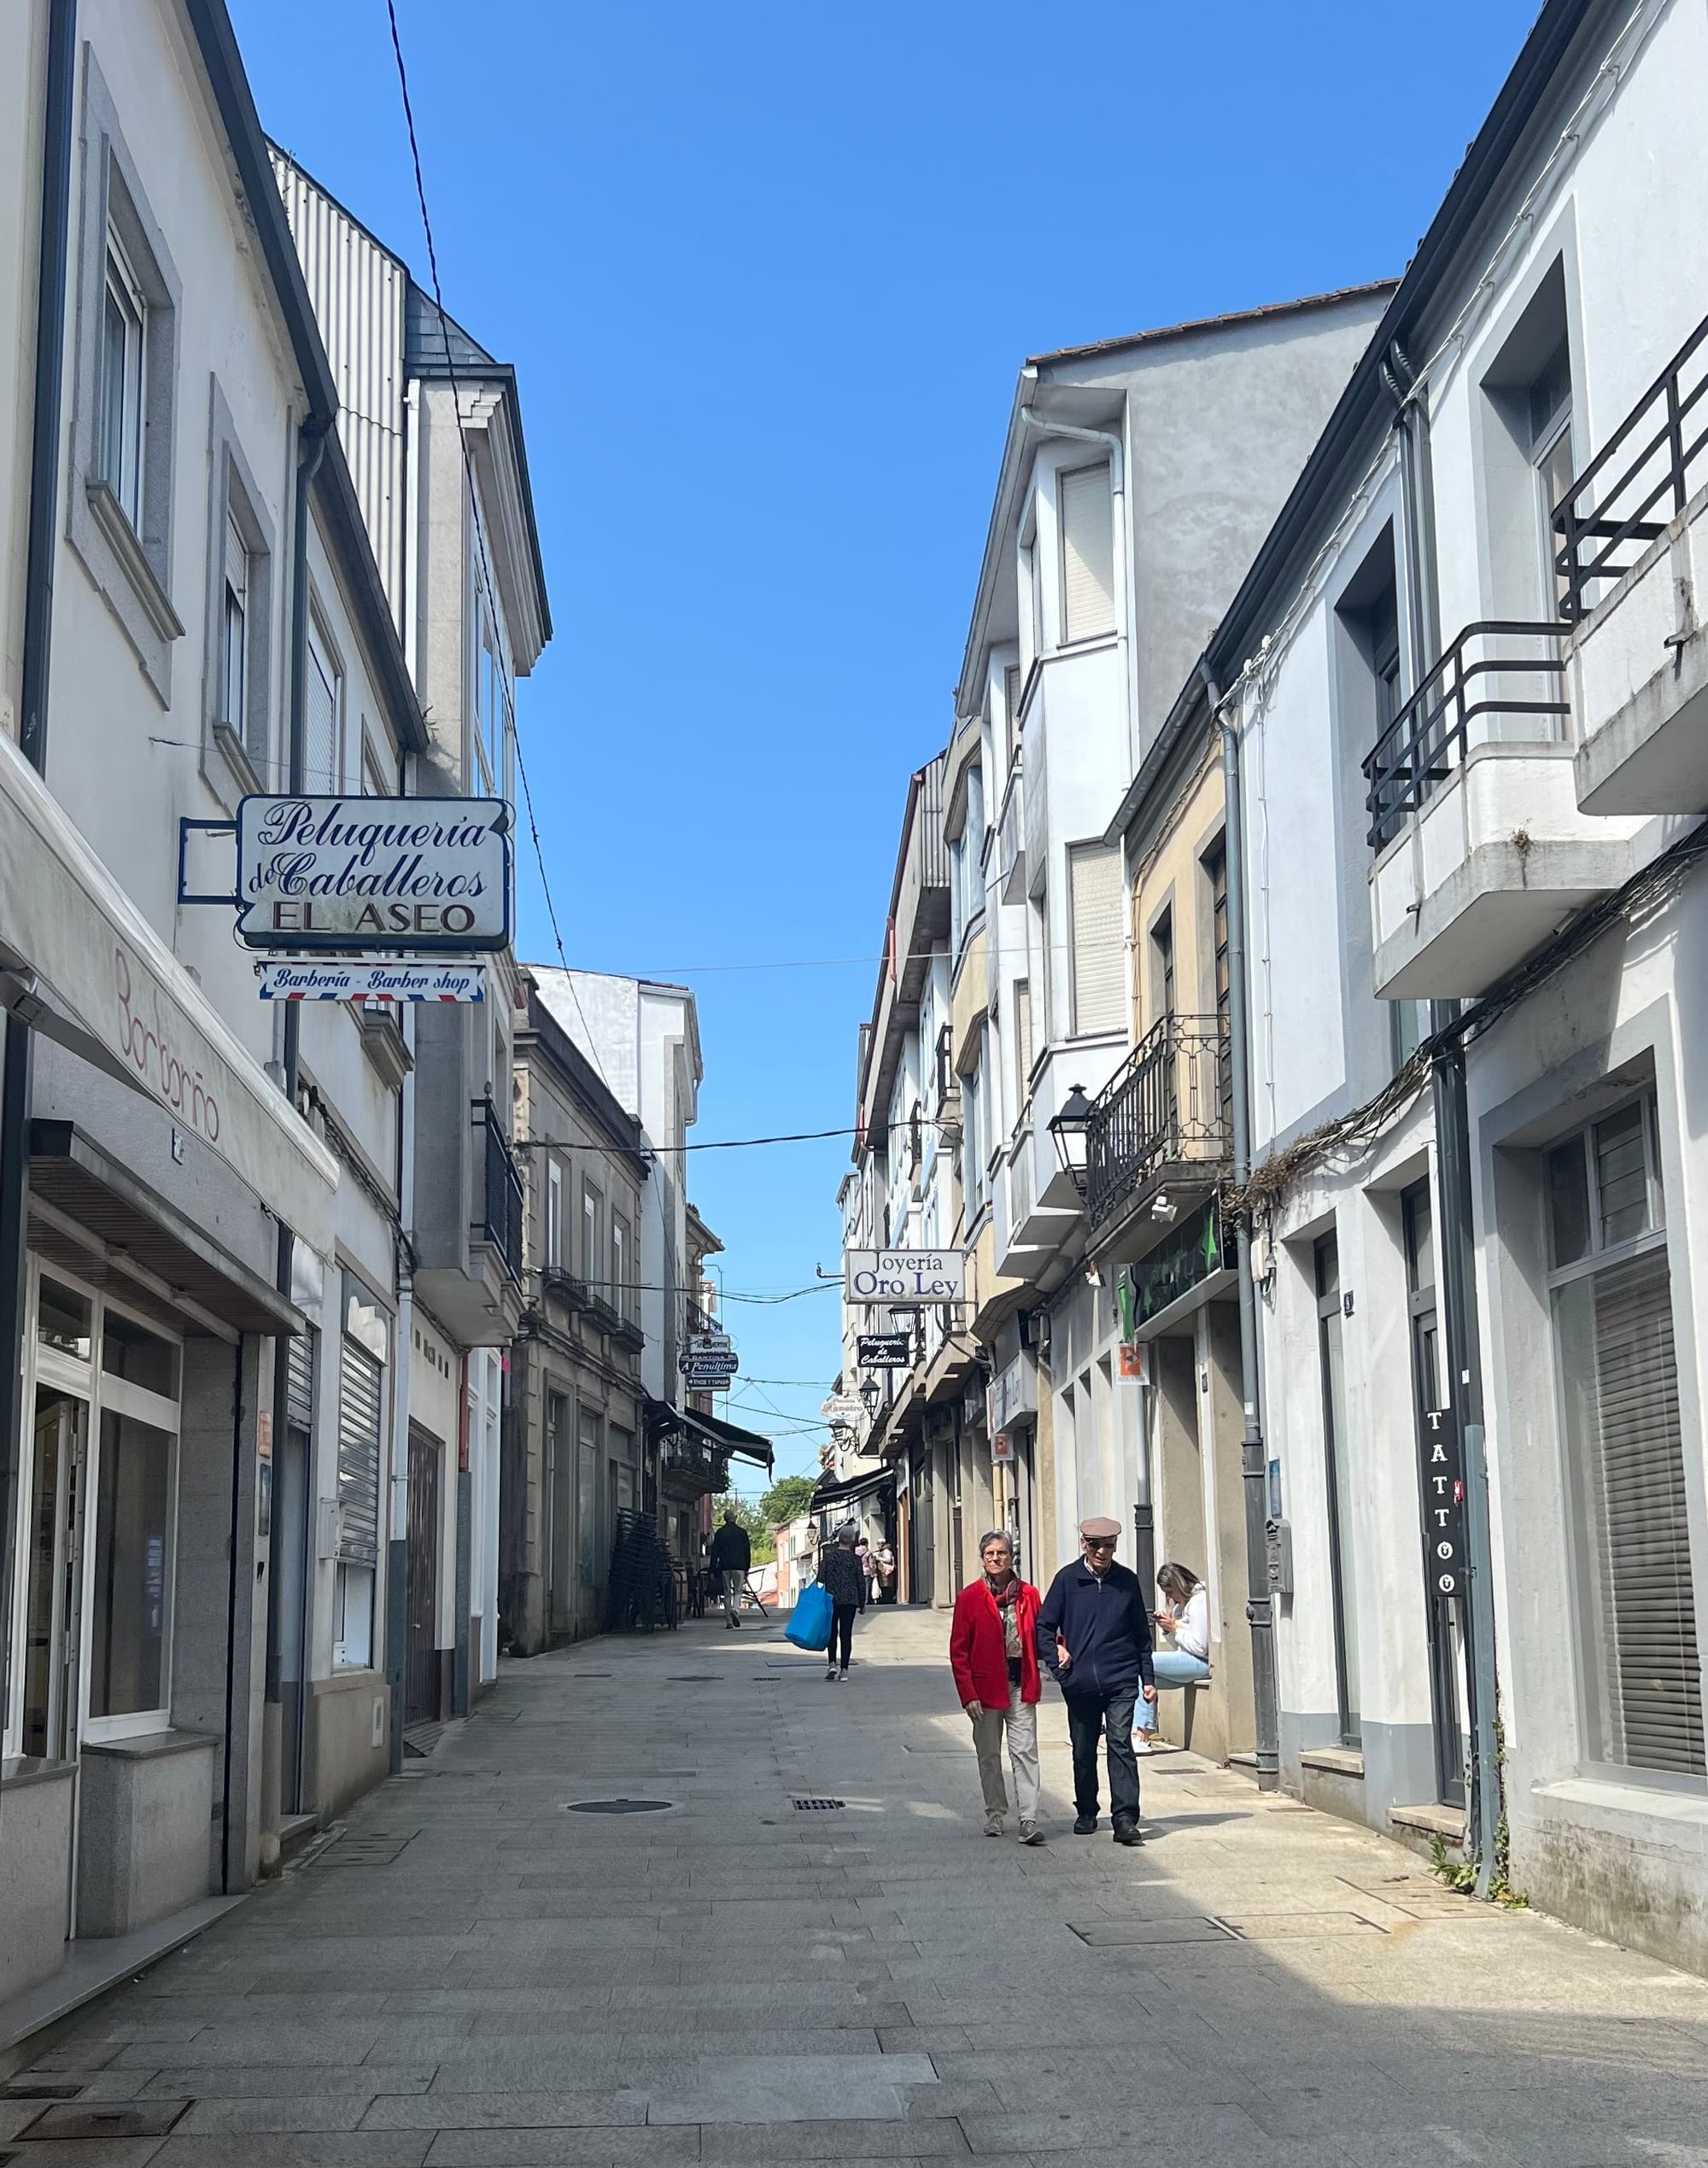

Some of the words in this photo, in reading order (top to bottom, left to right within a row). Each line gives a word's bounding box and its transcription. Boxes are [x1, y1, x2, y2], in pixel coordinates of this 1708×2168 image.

[258, 801, 487, 866] Peluquería
[249, 862, 274, 893] de
[271, 852, 488, 897] Caballeros
[272, 901, 331, 931] EL
[354, 903, 476, 932] ASEO
[273, 967, 351, 988] Barbería
[367, 970, 429, 991] Barber
[433, 972, 471, 994] shop
[873, 1251, 944, 1274] Joyería
[854, 1271, 905, 1295] Oro
[913, 1271, 958, 1300] Ley
[681, 1362, 690, 1371] A
[861, 1354, 905, 1364] Caballeros
[1428, 1411, 1455, 1592] TATTOO
